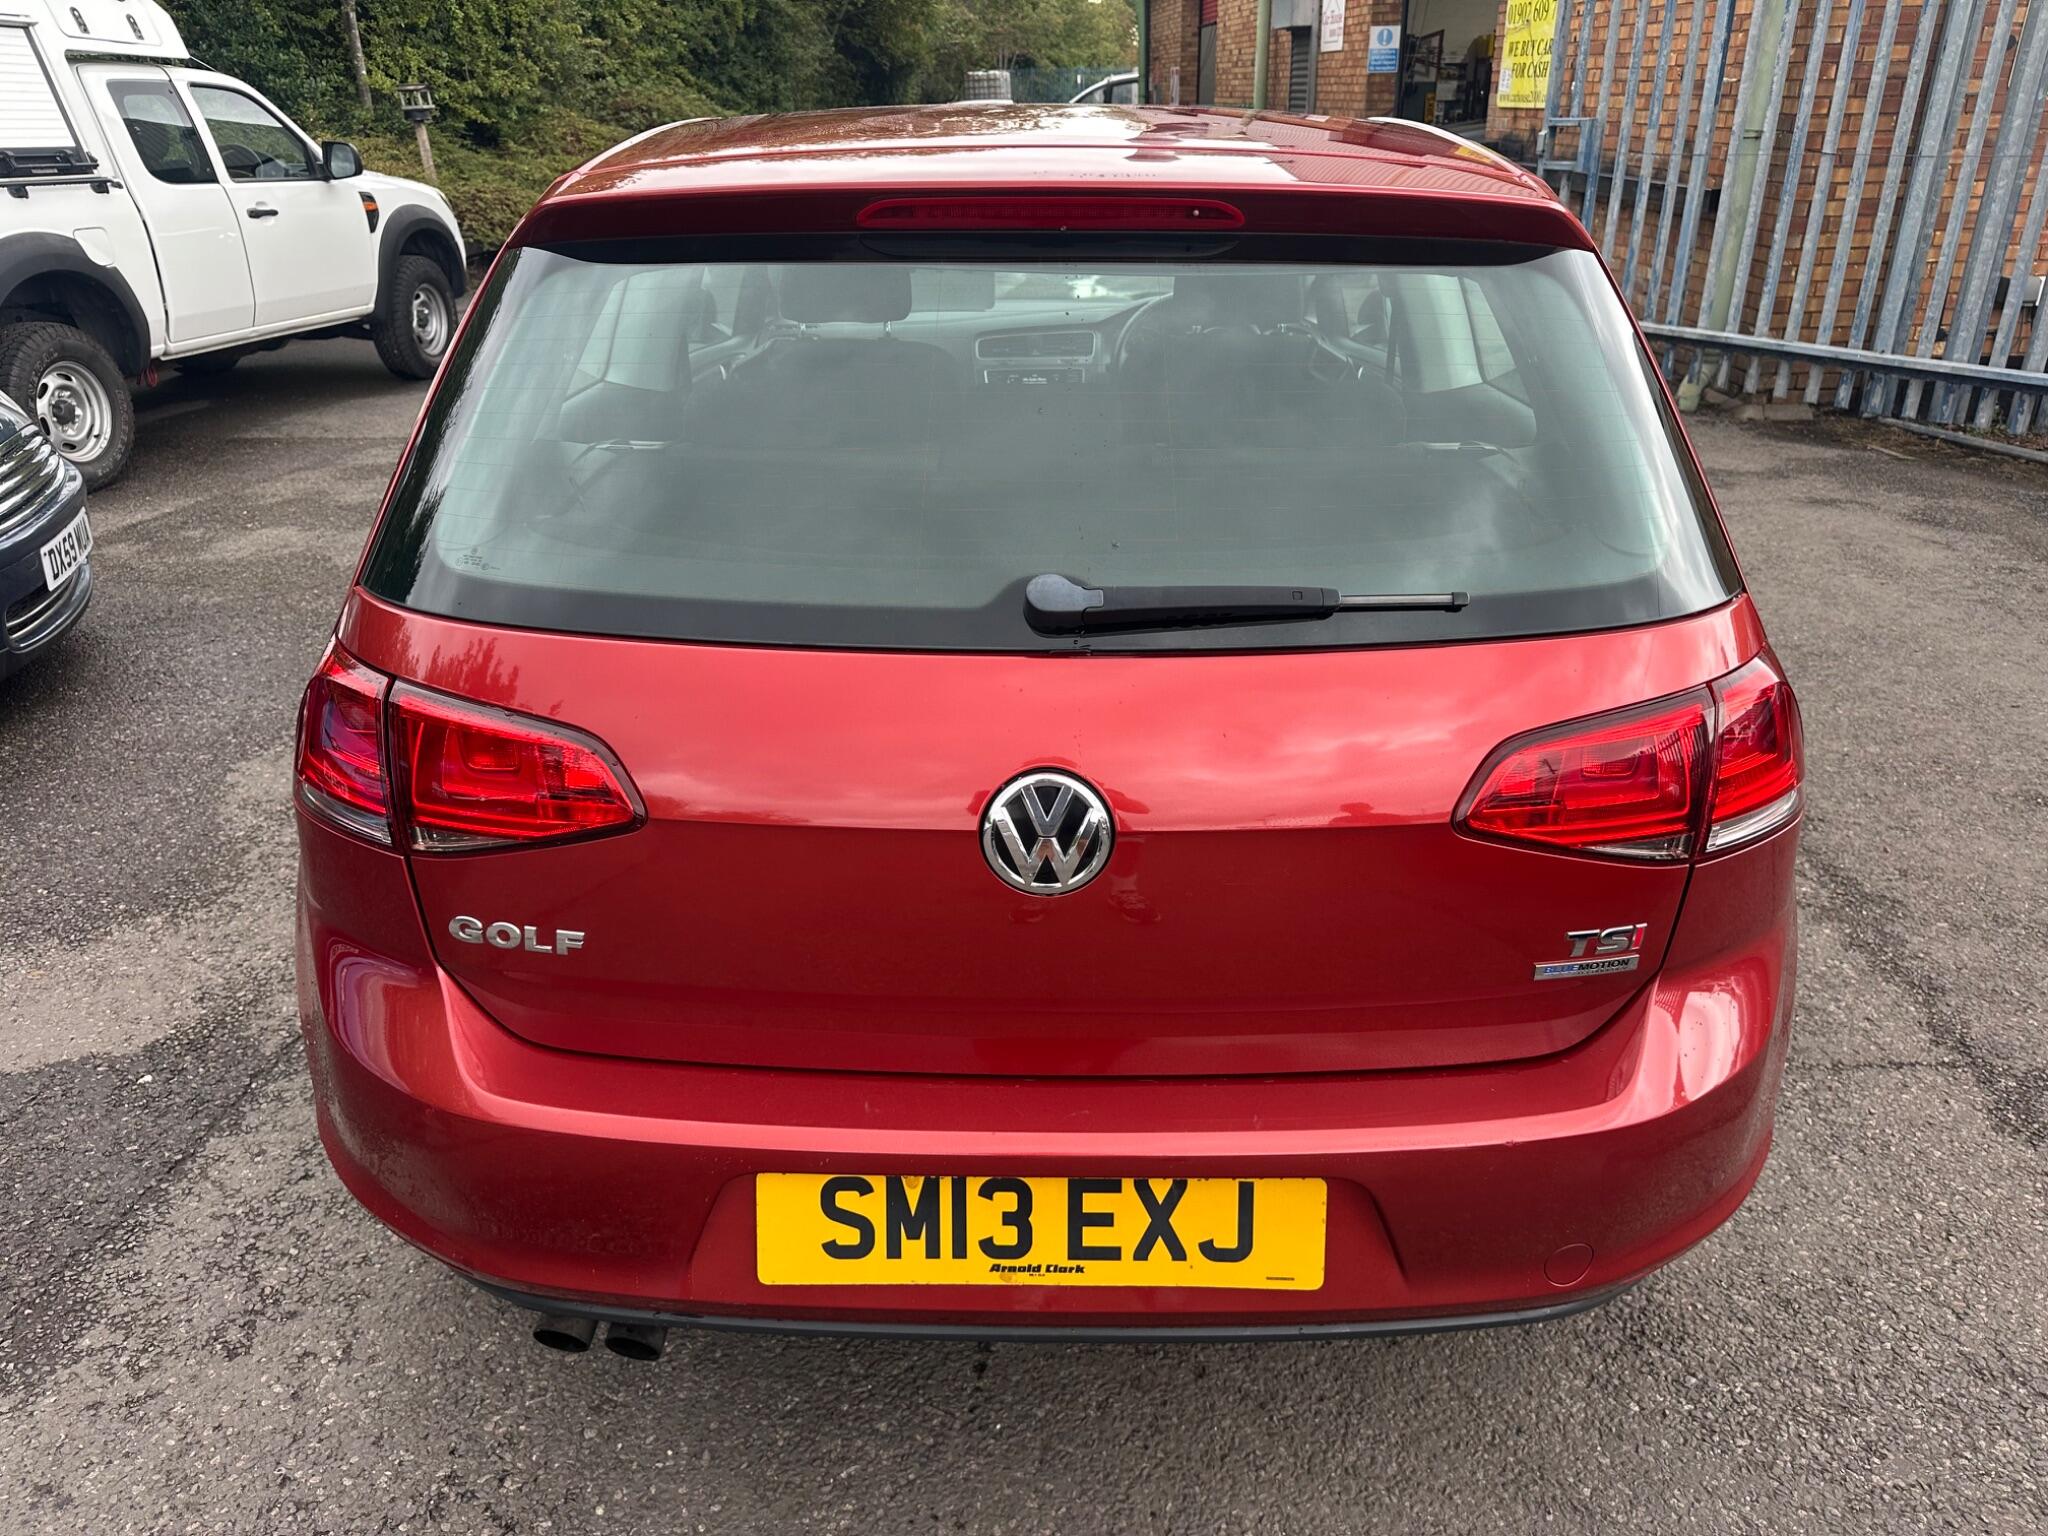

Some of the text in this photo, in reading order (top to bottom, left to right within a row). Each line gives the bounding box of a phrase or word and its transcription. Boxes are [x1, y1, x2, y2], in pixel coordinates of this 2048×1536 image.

[1508, 38, 1554, 57] WE BUY CAR
[1512, 60, 1549, 78] FOR CASH
[48, 531, 77, 581] DX59
[448, 915, 585, 955] GOLF
[820, 1176, 1255, 1263] SM13 EXJ
[989, 1263, 1085, 1274] Arnold Clark
